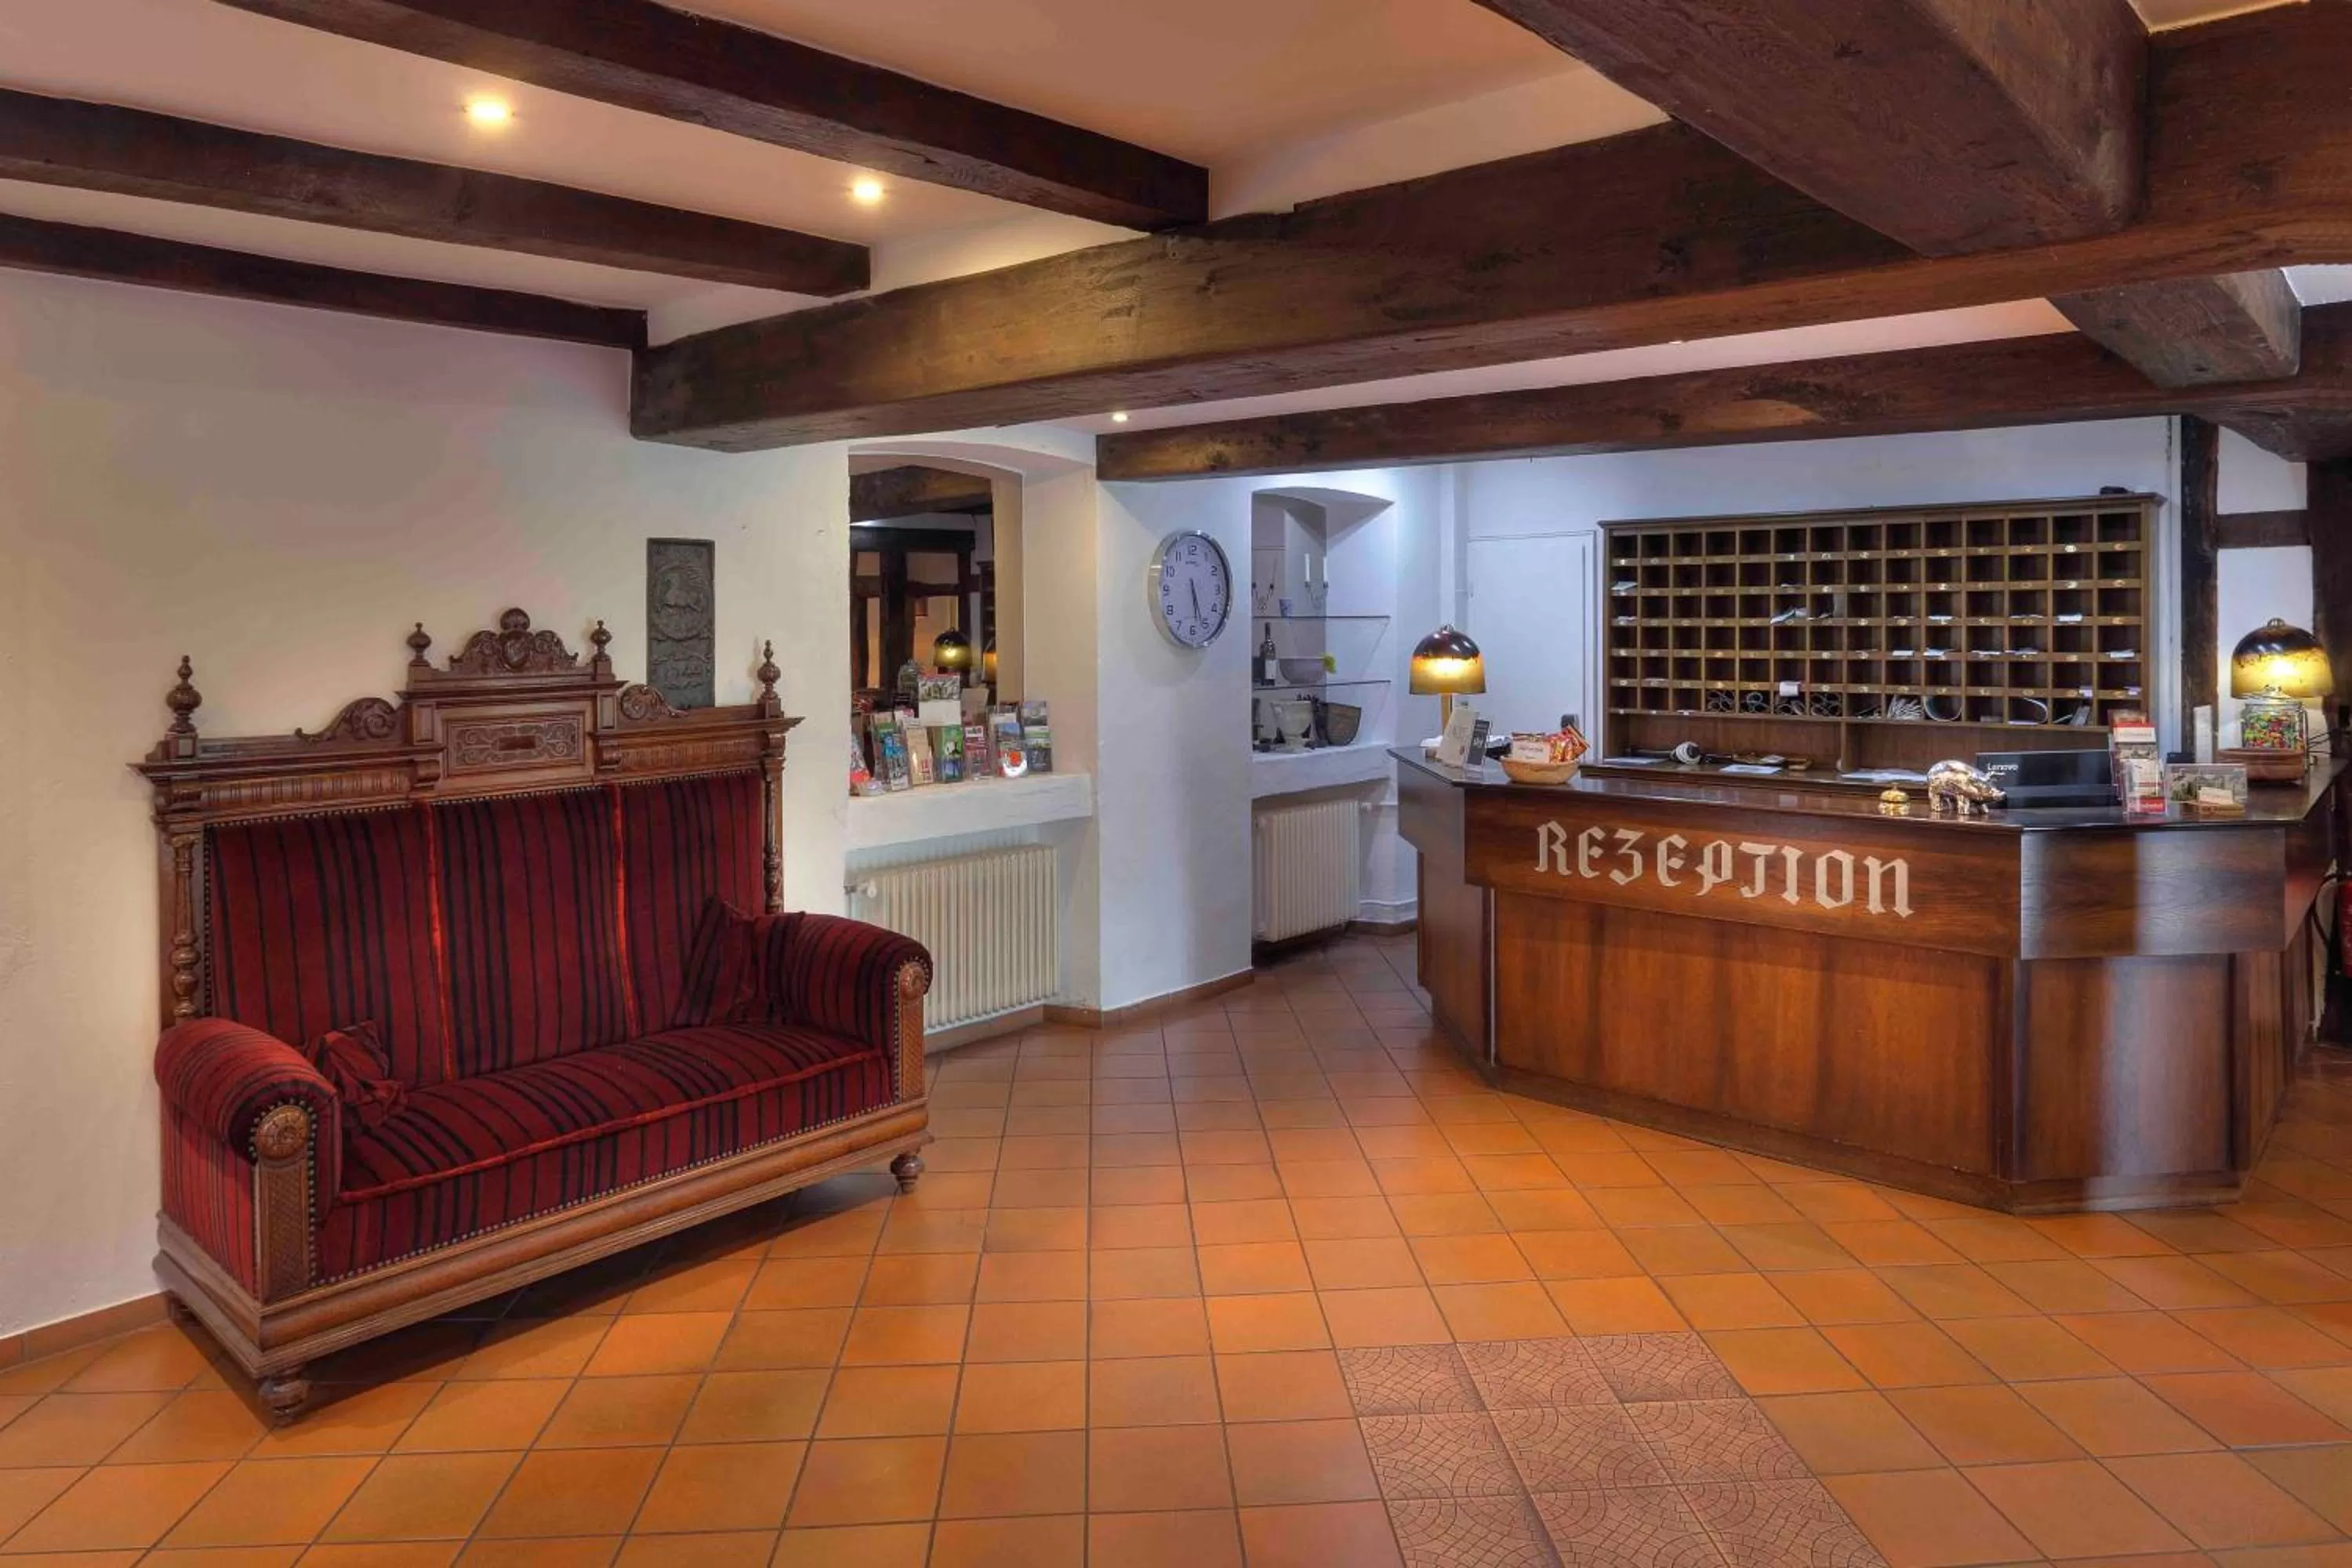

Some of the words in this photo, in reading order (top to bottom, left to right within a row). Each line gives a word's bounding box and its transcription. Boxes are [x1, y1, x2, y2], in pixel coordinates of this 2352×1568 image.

[1210, 565, 1218, 576] 2
[1163, 585, 1170, 596] 9
[1166, 604, 1174, 615] 8
[1211, 602, 1218, 613] 4
[1175, 620, 1181, 630] 7
[1202, 618, 1209, 629] 5
[1189, 625, 1196, 636] 6
[1987, 762, 2019, 771] Lenovo
